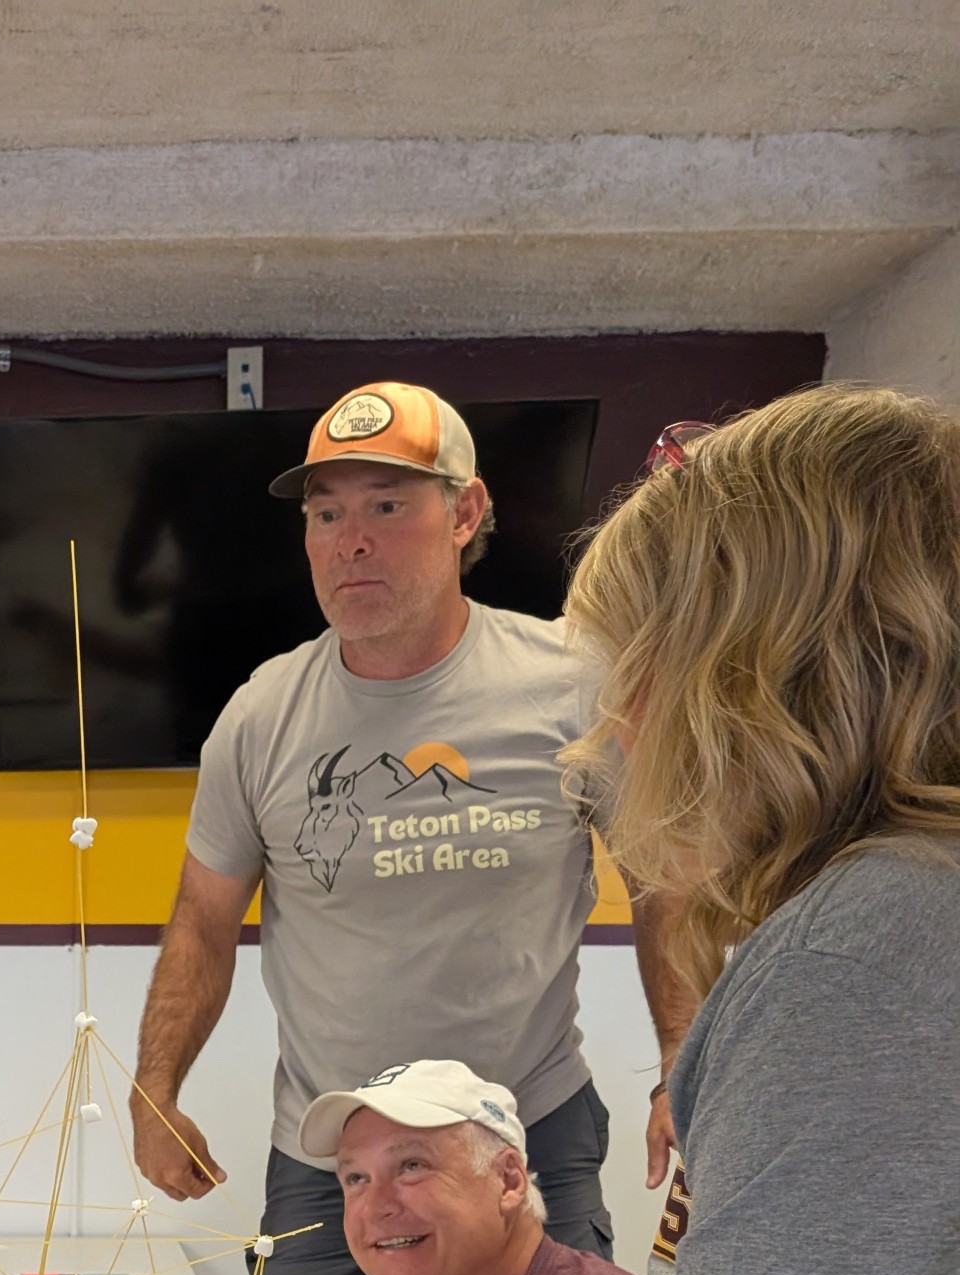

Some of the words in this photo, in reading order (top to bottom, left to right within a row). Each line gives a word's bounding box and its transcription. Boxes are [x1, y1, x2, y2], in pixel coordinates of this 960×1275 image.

[367, 813, 461, 843] Teton
[468, 805, 542, 833] Pass
[373, 845, 425, 878] Ski
[433, 843, 511, 871] Area
